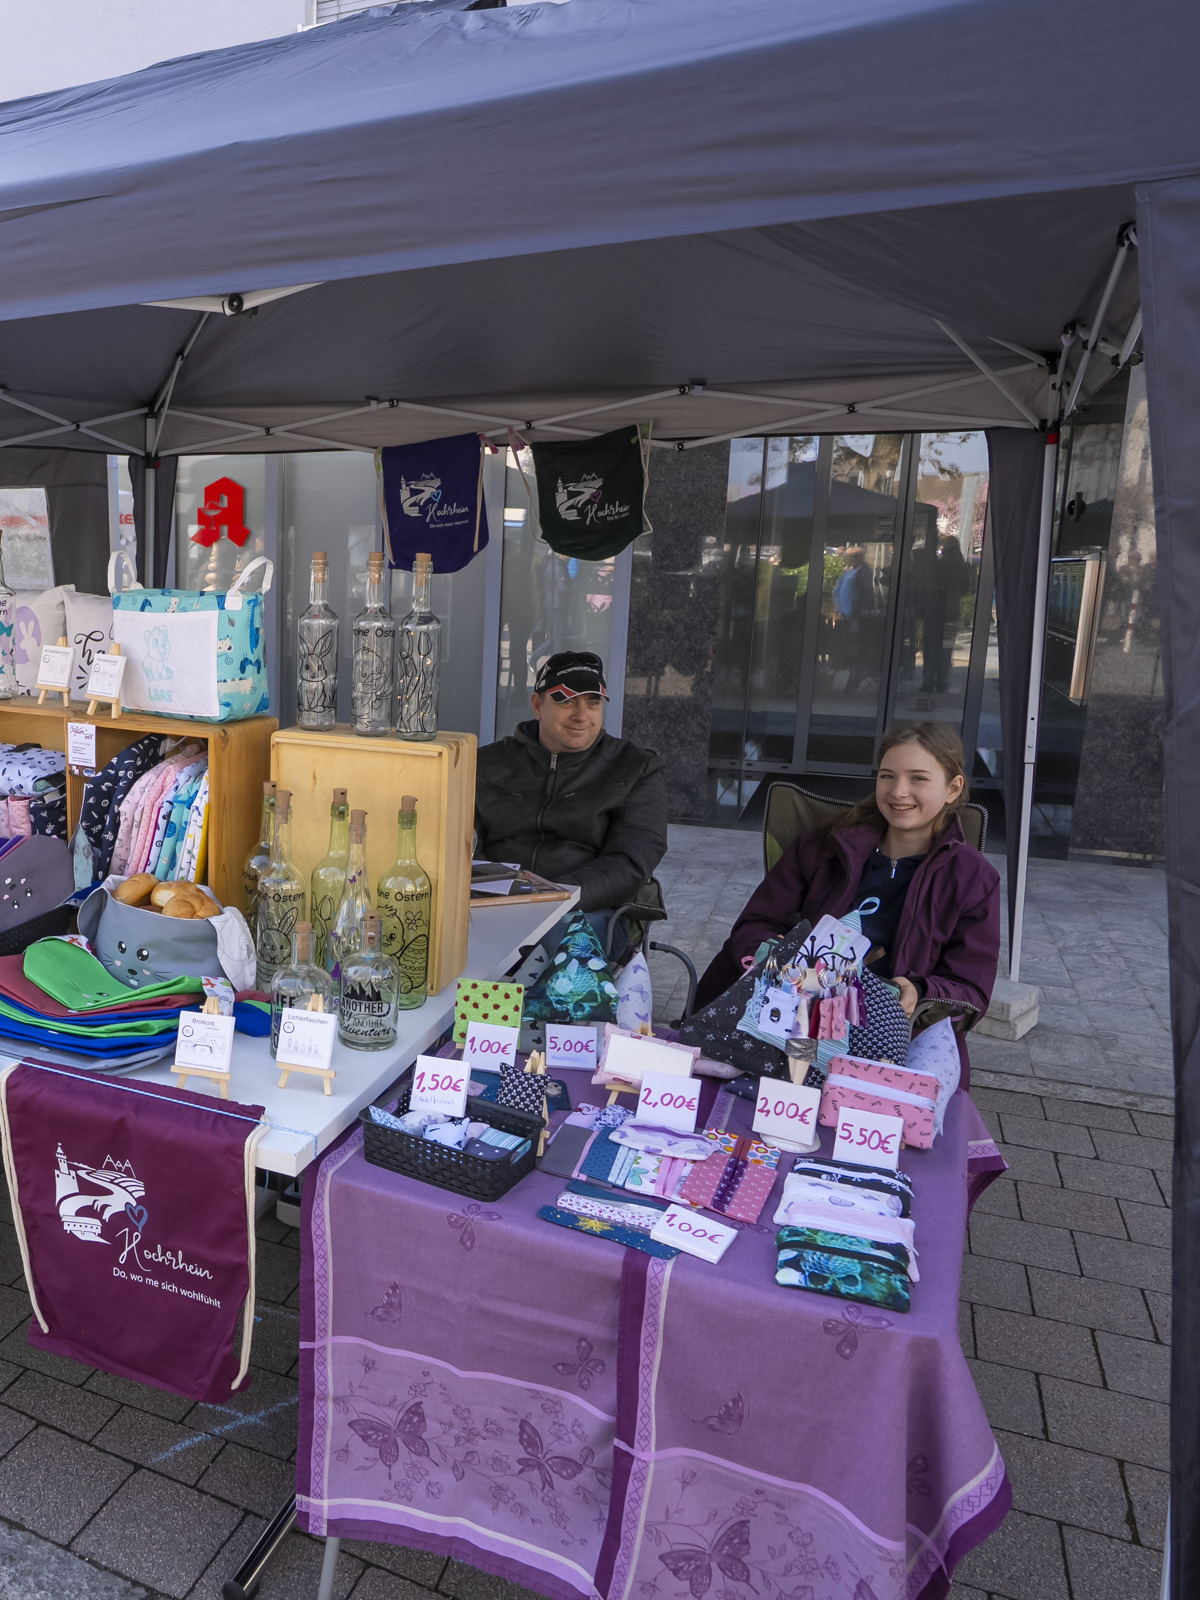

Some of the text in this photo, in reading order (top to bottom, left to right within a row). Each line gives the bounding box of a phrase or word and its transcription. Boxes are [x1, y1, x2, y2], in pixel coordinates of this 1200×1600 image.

[353, 627, 396, 638] ohe Ost
[272, 891, 305, 903] Ostern
[394, 891, 430, 902] Ostern
[341, 997, 384, 1014] ANOTHER
[192, 1017, 216, 1027] Brotkorb
[287, 1013, 329, 1025] Lichterflaschen
[468, 1036, 513, 1056] 1,00€
[548, 1035, 595, 1054] 5,00€
[415, 1071, 465, 1093] 1,50€
[641, 1087, 697, 1111] 2,00€
[757, 1097, 814, 1125] 2,00€
[838, 1122, 897, 1155] 5,50€
[666, 1213, 725, 1245] 1,00€
[115, 1227, 213, 1280] Hochrhein
[113, 1266, 222, 1309] Do, wo me sich wohlfühlt
